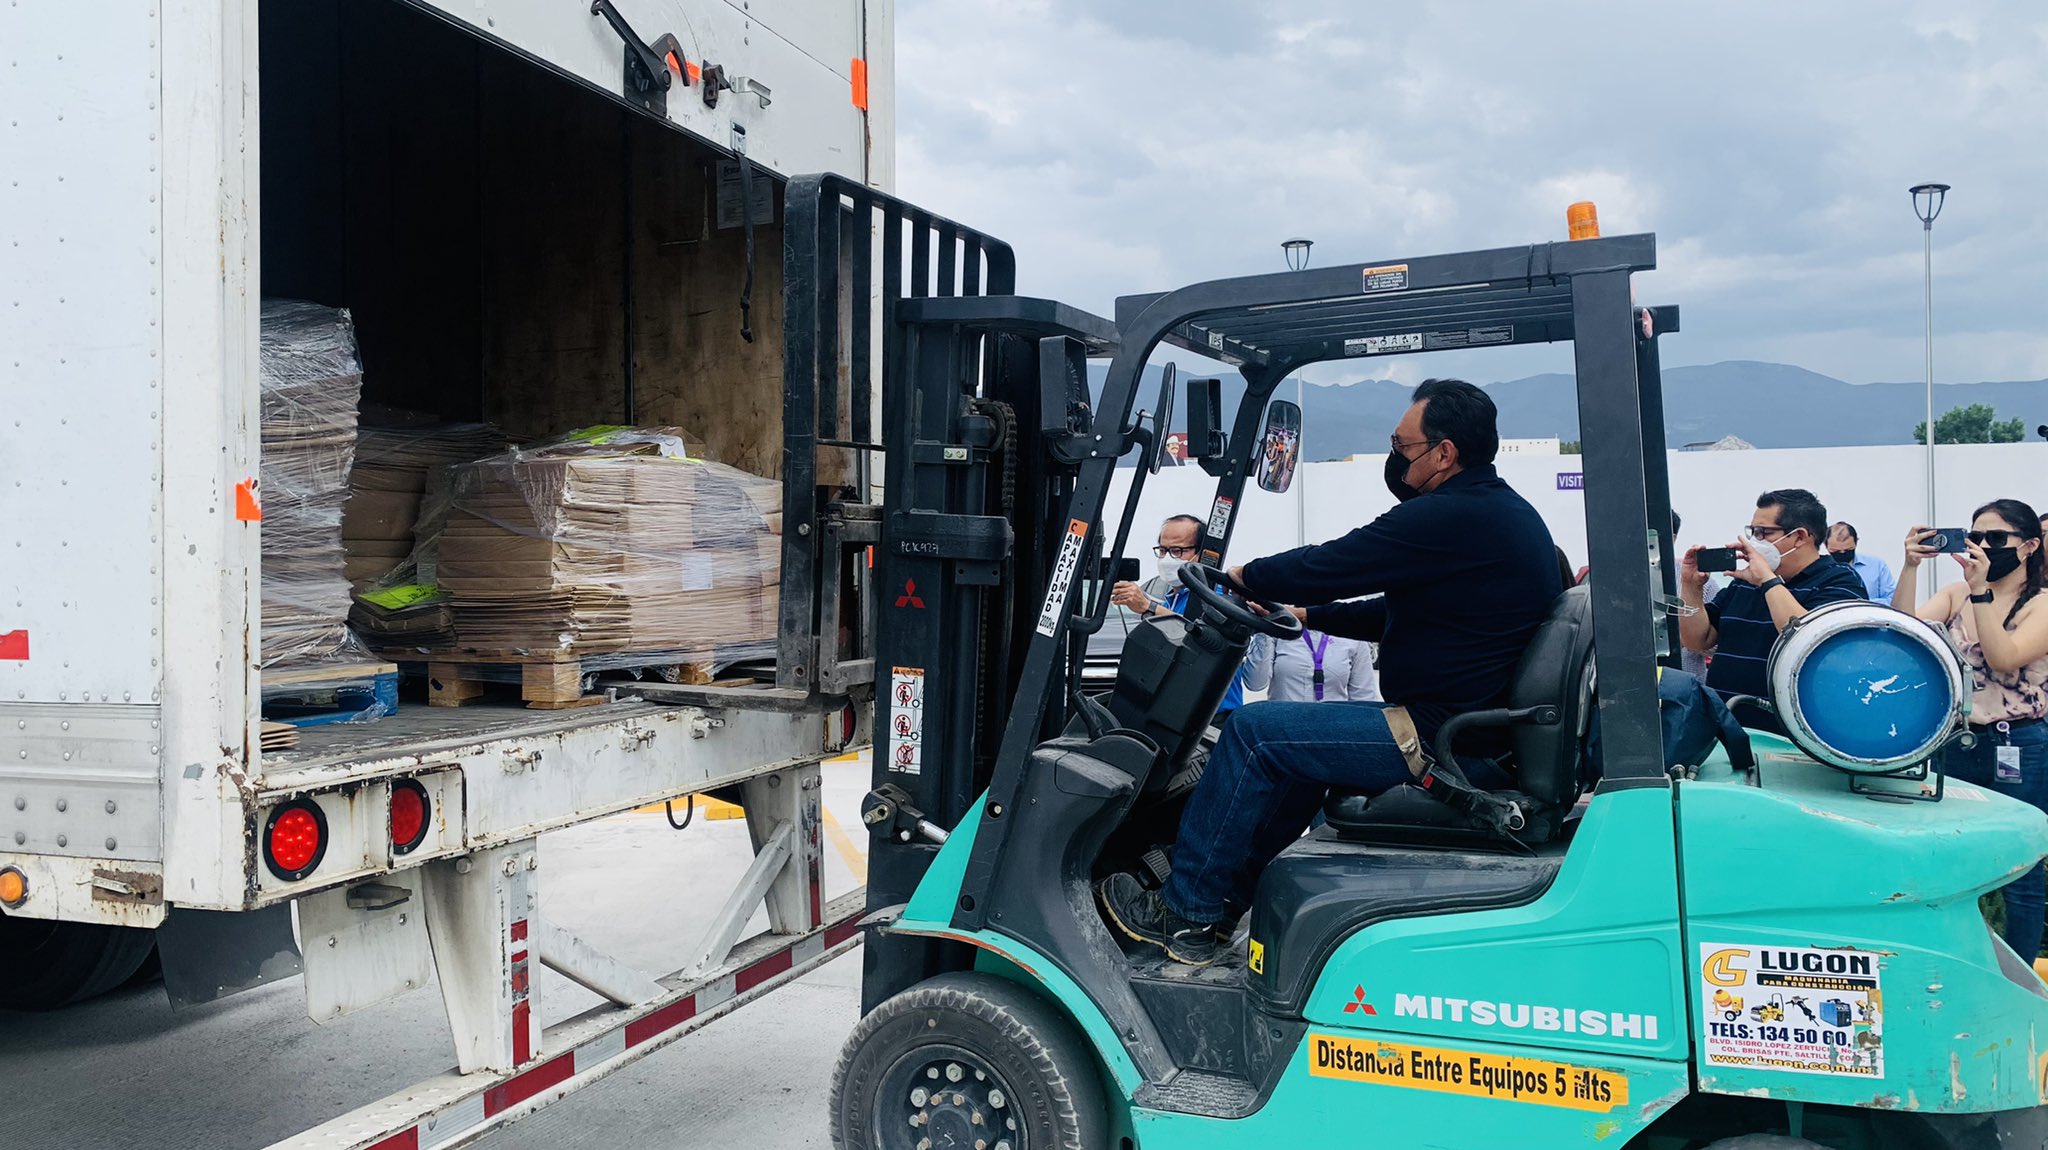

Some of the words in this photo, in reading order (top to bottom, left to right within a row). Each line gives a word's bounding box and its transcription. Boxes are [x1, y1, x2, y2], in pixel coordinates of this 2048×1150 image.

[1558, 475, 1584, 488] VISIT
[1045, 523, 1078, 612] CAPACIDAD
[1055, 535, 1082, 605] MAXIMA
[1761, 951, 1871, 975] LUGON
[1784, 975, 1849, 984] MAQUINARIA
[1394, 992, 1658, 1040] MITSUBISHI
[1709, 1022, 1754, 1039] TELS:
[1757, 1025, 1789, 1042] 134
[1794, 1028, 1817, 1044] 50
[1710, 1038, 1732, 1046] BLVD.
[1735, 1040, 1763, 1048] ISIDRO
[1765, 1042, 1791, 1050] LOPEZ
[1794, 1044, 1830, 1053] ZERTUC
[1795, 1052, 1831, 1060] SALTILL
[1317, 1040, 1405, 1078] Distancia
[1411, 1051, 1463, 1084] Entre
[1469, 1057, 1548, 1098] Equipos
[1555, 1068, 1567, 1097] 5
[1574, 1071, 1612, 1103] Mts
